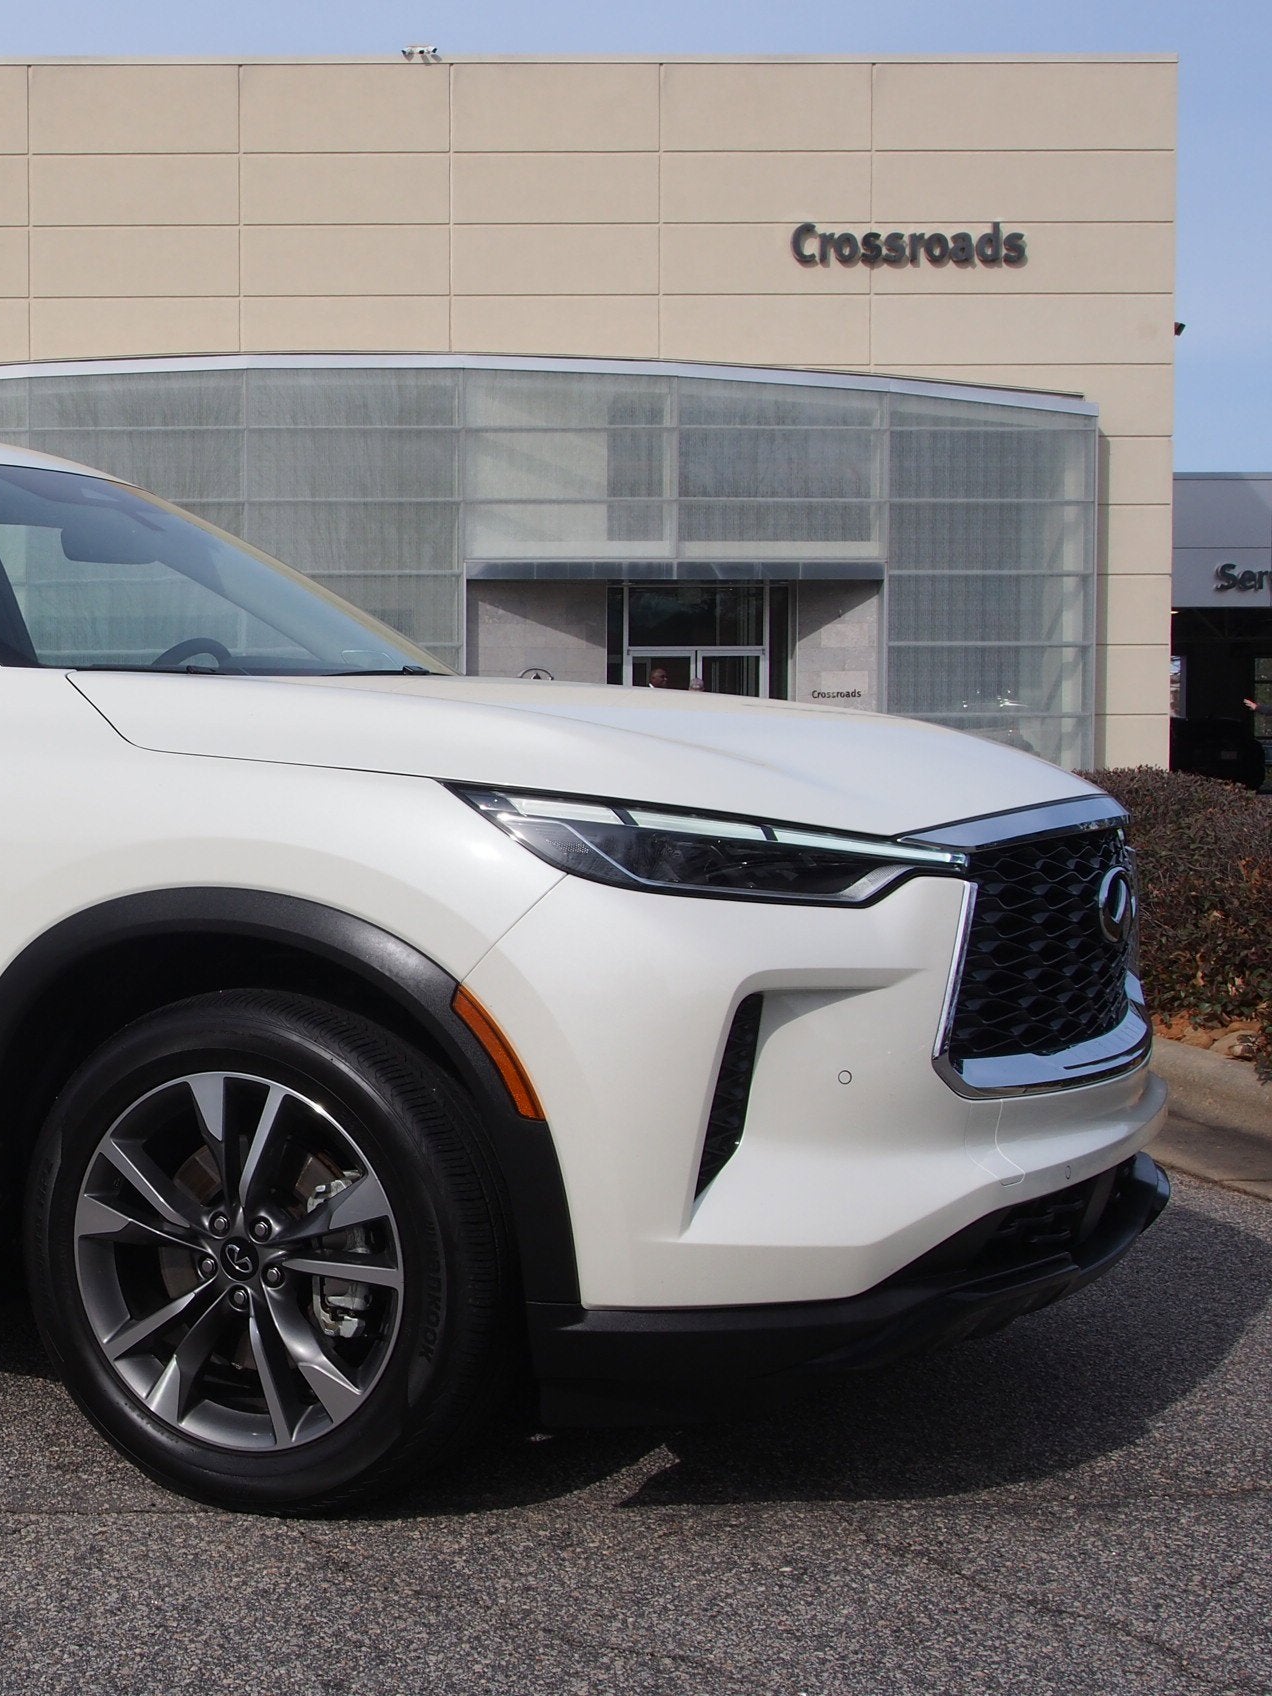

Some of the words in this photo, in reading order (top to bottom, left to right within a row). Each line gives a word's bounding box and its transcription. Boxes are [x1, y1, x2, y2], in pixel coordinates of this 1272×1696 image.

[790, 222, 1026, 264] Crossroads
[1216, 563, 1272, 591] Ser
[811, 688, 862, 699] Crossroads
